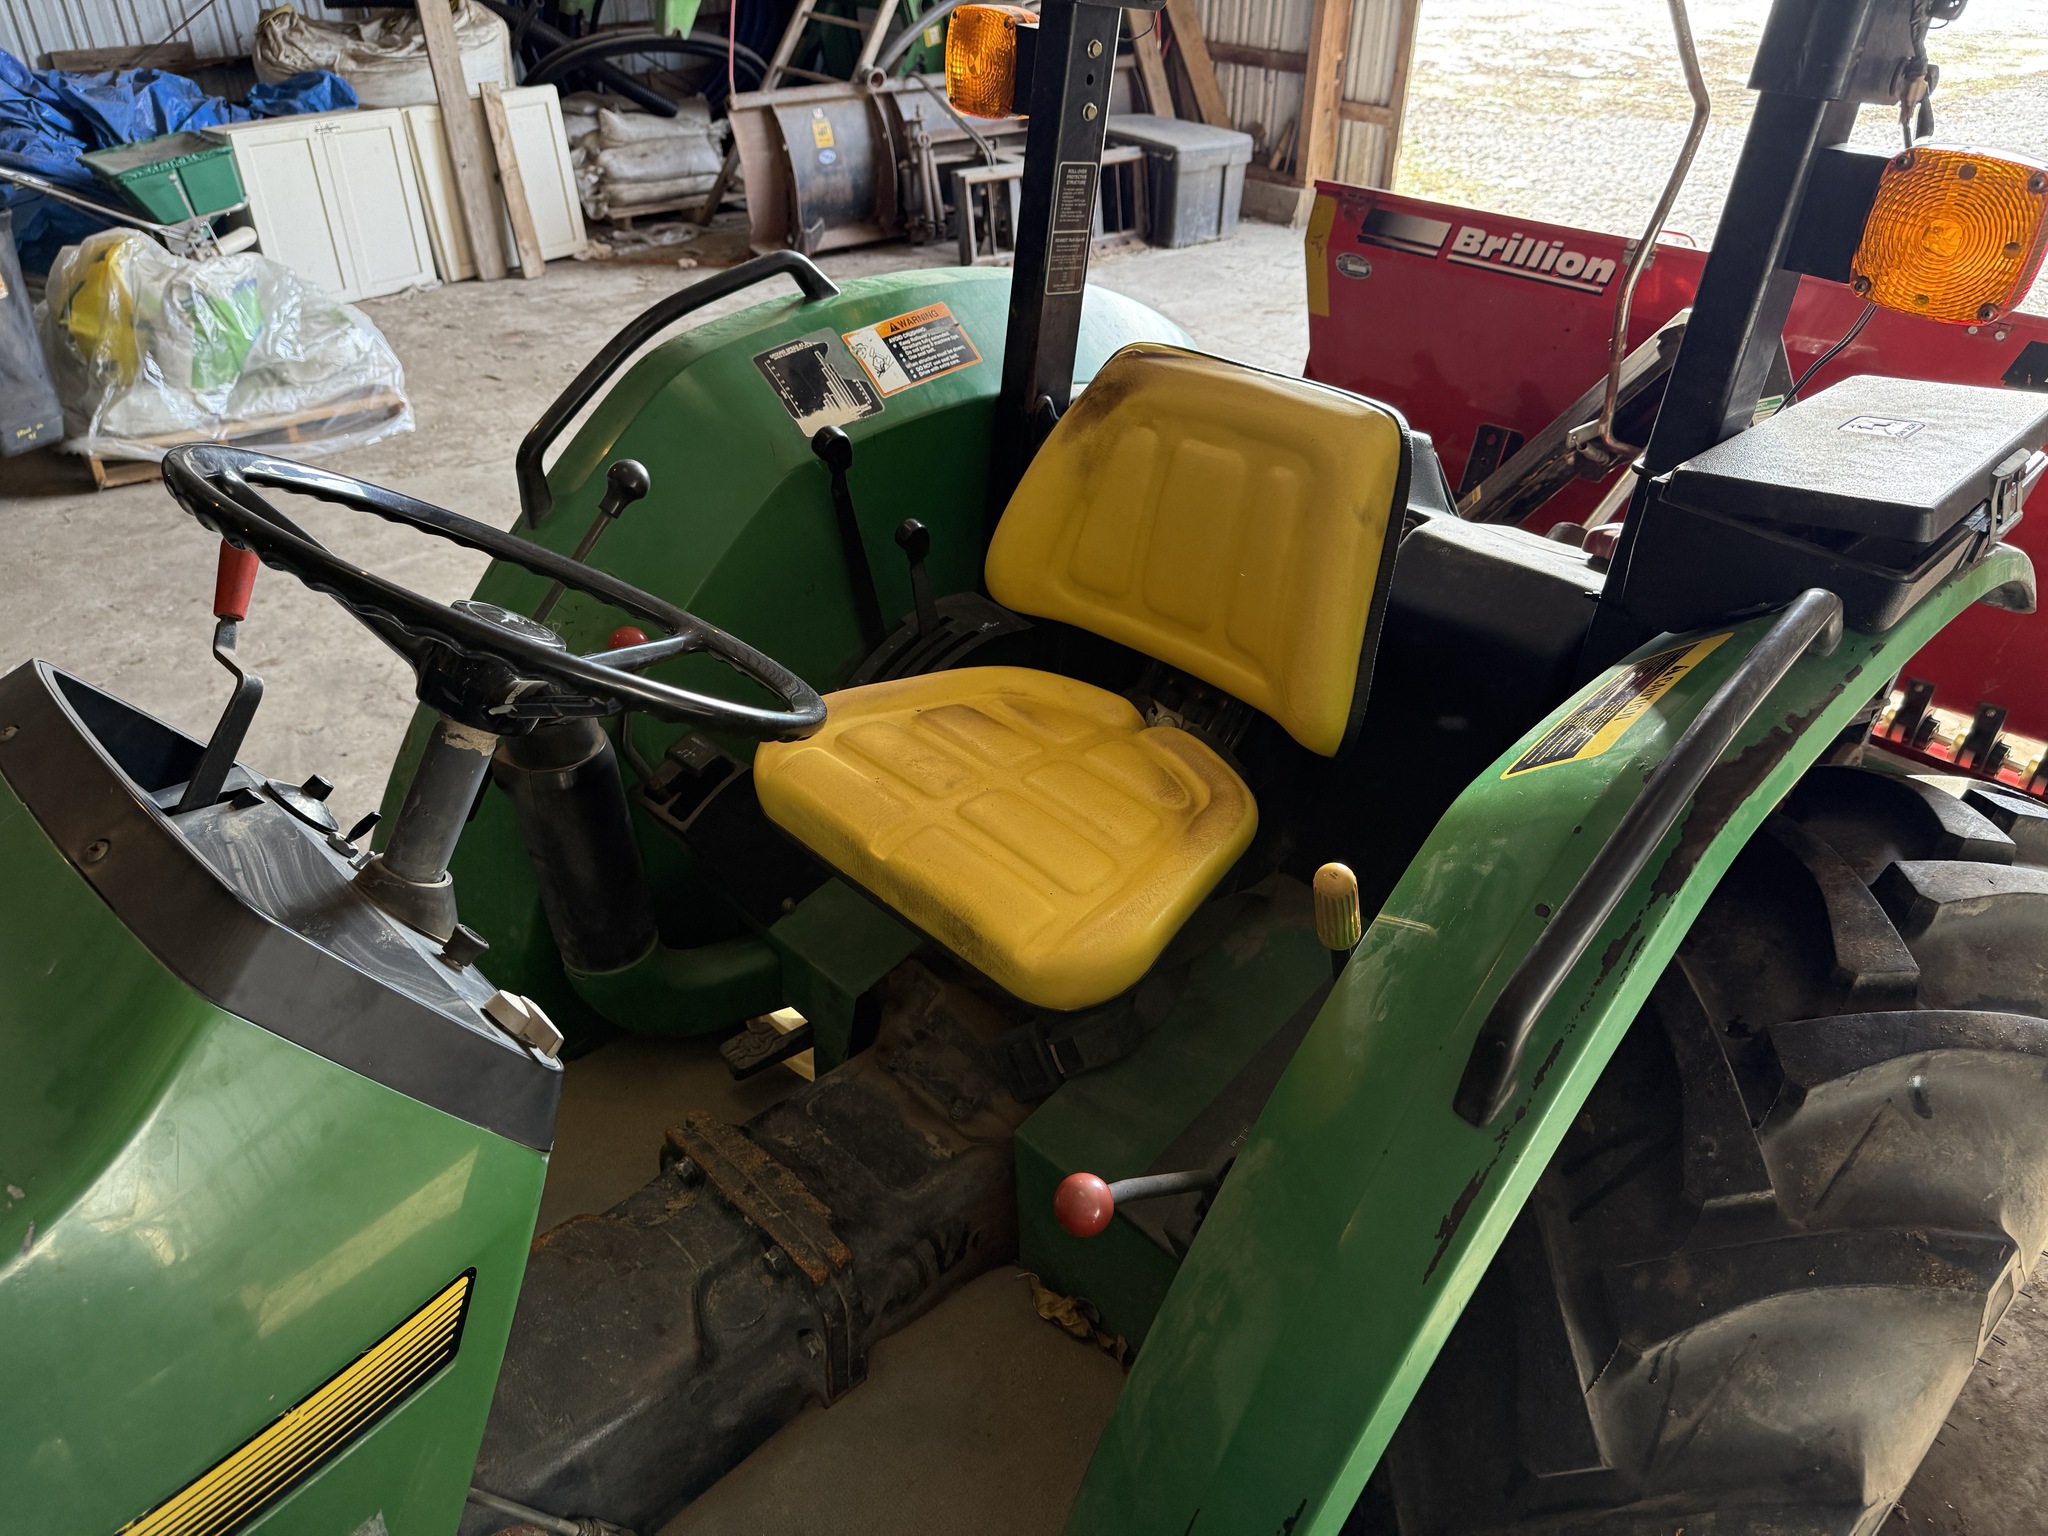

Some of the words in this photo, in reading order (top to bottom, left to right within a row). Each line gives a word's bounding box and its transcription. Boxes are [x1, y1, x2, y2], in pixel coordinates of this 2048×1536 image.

[1451, 225, 1616, 284] Brillion
[898, 310, 938, 328] WARNING
[888, 335, 903, 343] AVOID
[902, 341, 922, 350] Structure
[918, 355, 937, 364] structure
[1613, 676, 1674, 721] CAUTION
